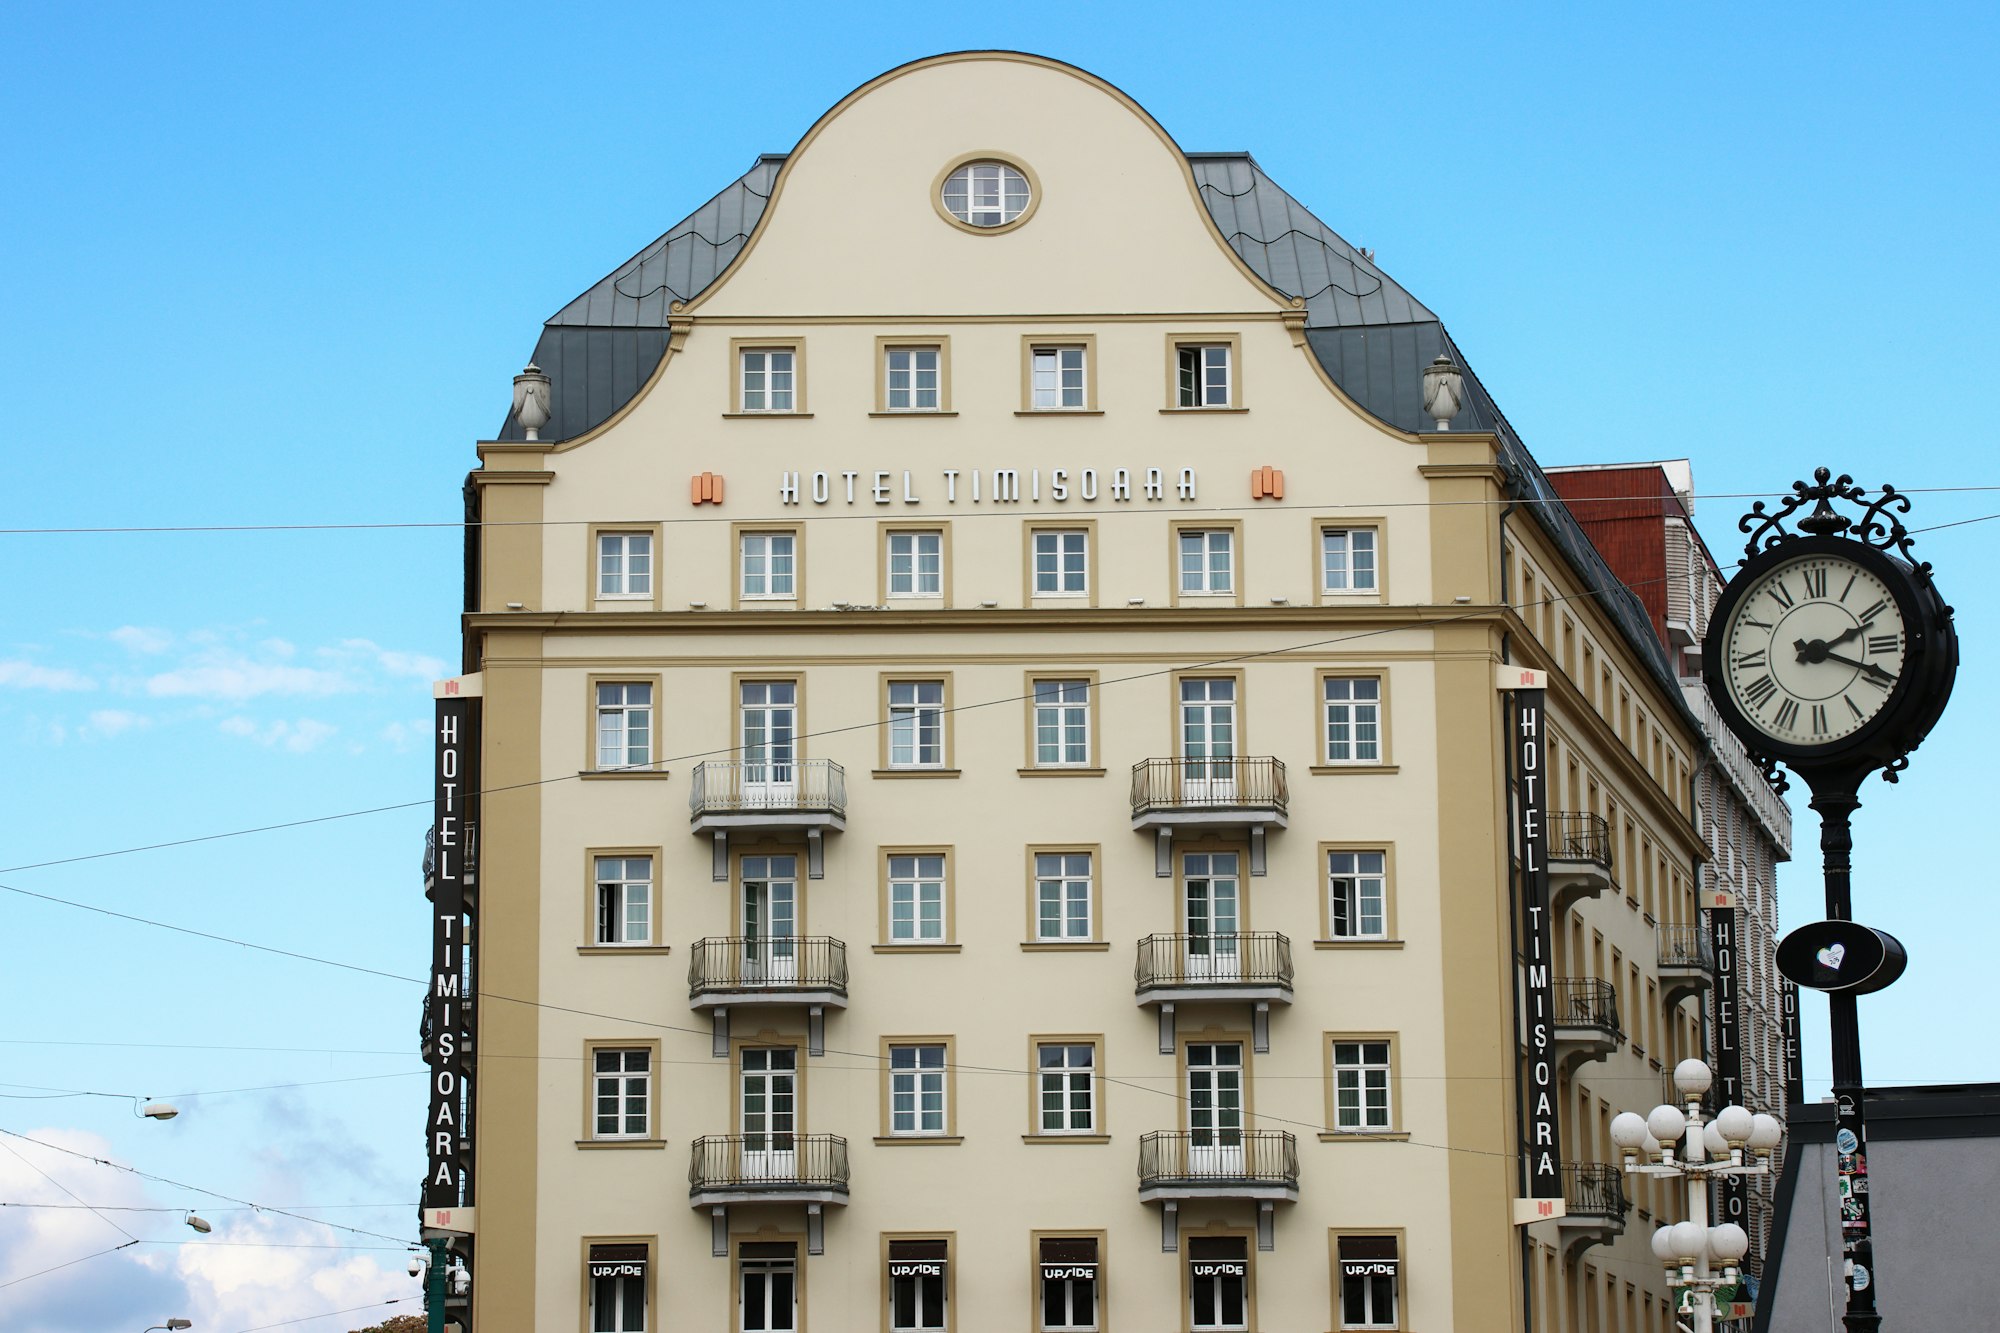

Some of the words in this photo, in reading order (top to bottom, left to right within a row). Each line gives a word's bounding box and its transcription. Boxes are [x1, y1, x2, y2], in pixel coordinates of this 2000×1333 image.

[780, 469, 920, 505] HOTEL
[943, 466, 1197, 504] TIMISOARA
[1767, 581, 1794, 614] XI
[1802, 568, 1827, 600] XII
[1839, 574, 1857, 603] I
[1744, 613, 1773, 635] X
[1858, 599, 1888, 624] II
[1738, 647, 1766, 669] IX
[1868, 633, 1899, 655] III
[1744, 674, 1778, 711] VIII
[1773, 697, 1800, 732] VII
[1811, 704, 1828, 735] VI
[1843, 694, 1864, 722] V
[440, 715, 459, 880] HOTEL
[1520, 707, 1540, 872] HOTEL
[1716, 922, 1734, 1051] HOTEL
[592, 1264, 642, 1277] UPSIDE
[891, 1263, 941, 1276] UPSIDE
[1044, 1267, 1094, 1279] UPSIDE
[1194, 1263, 1244, 1276] UPSIDE
[1345, 1263, 1395, 1276] UPSIDE
